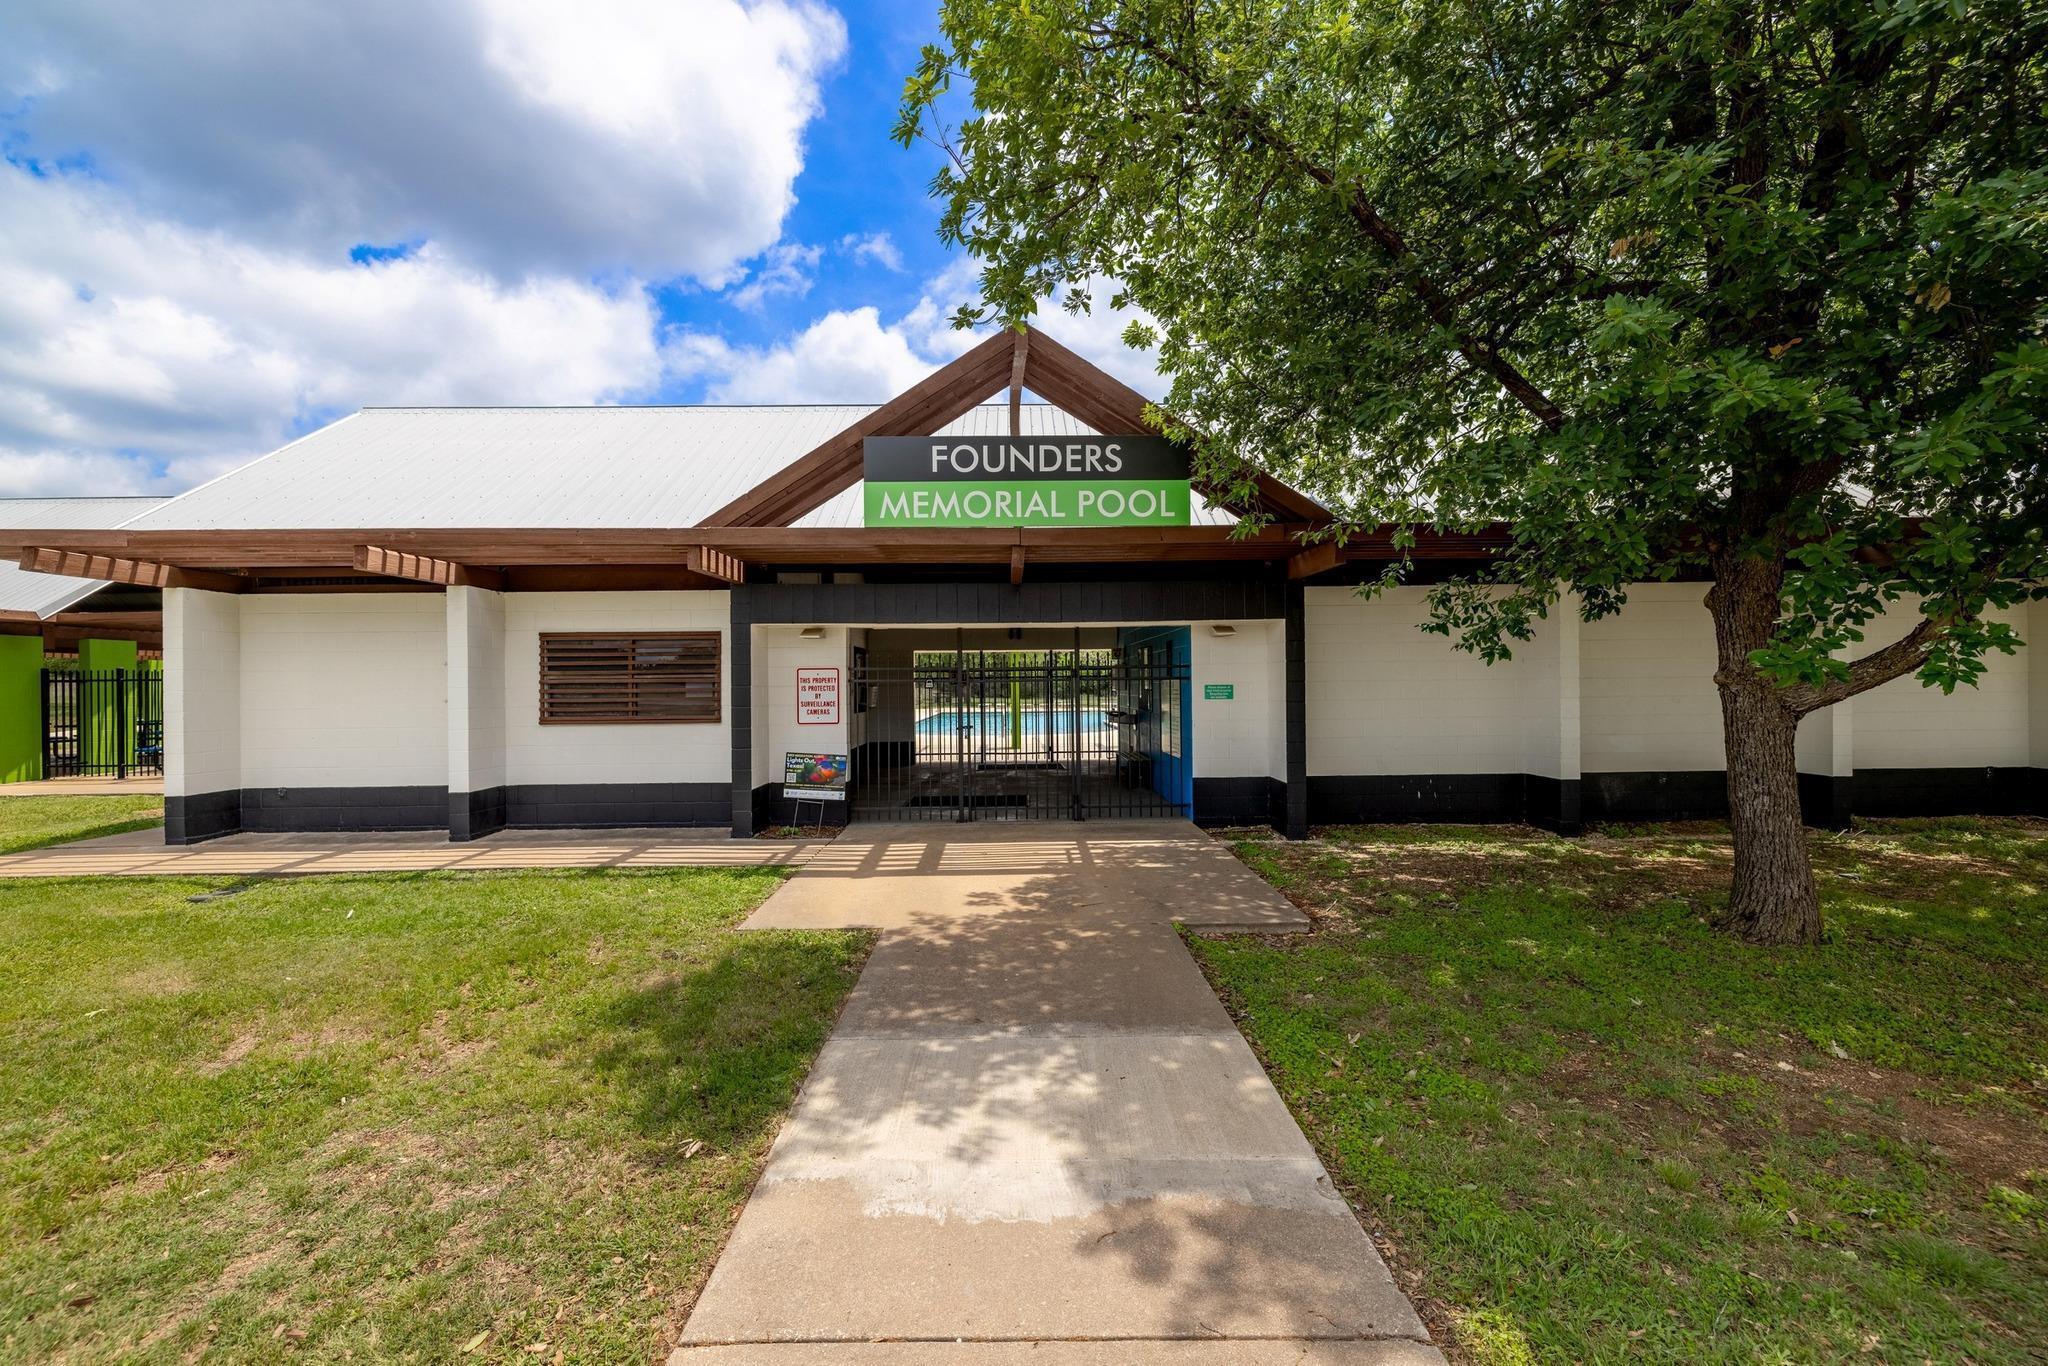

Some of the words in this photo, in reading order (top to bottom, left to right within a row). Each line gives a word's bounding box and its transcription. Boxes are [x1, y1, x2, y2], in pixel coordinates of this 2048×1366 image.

[931, 444, 1123, 473] FOUNDERS
[879, 489, 1066, 519] MEMORIAL
[1078, 489, 1176, 518] POOL
